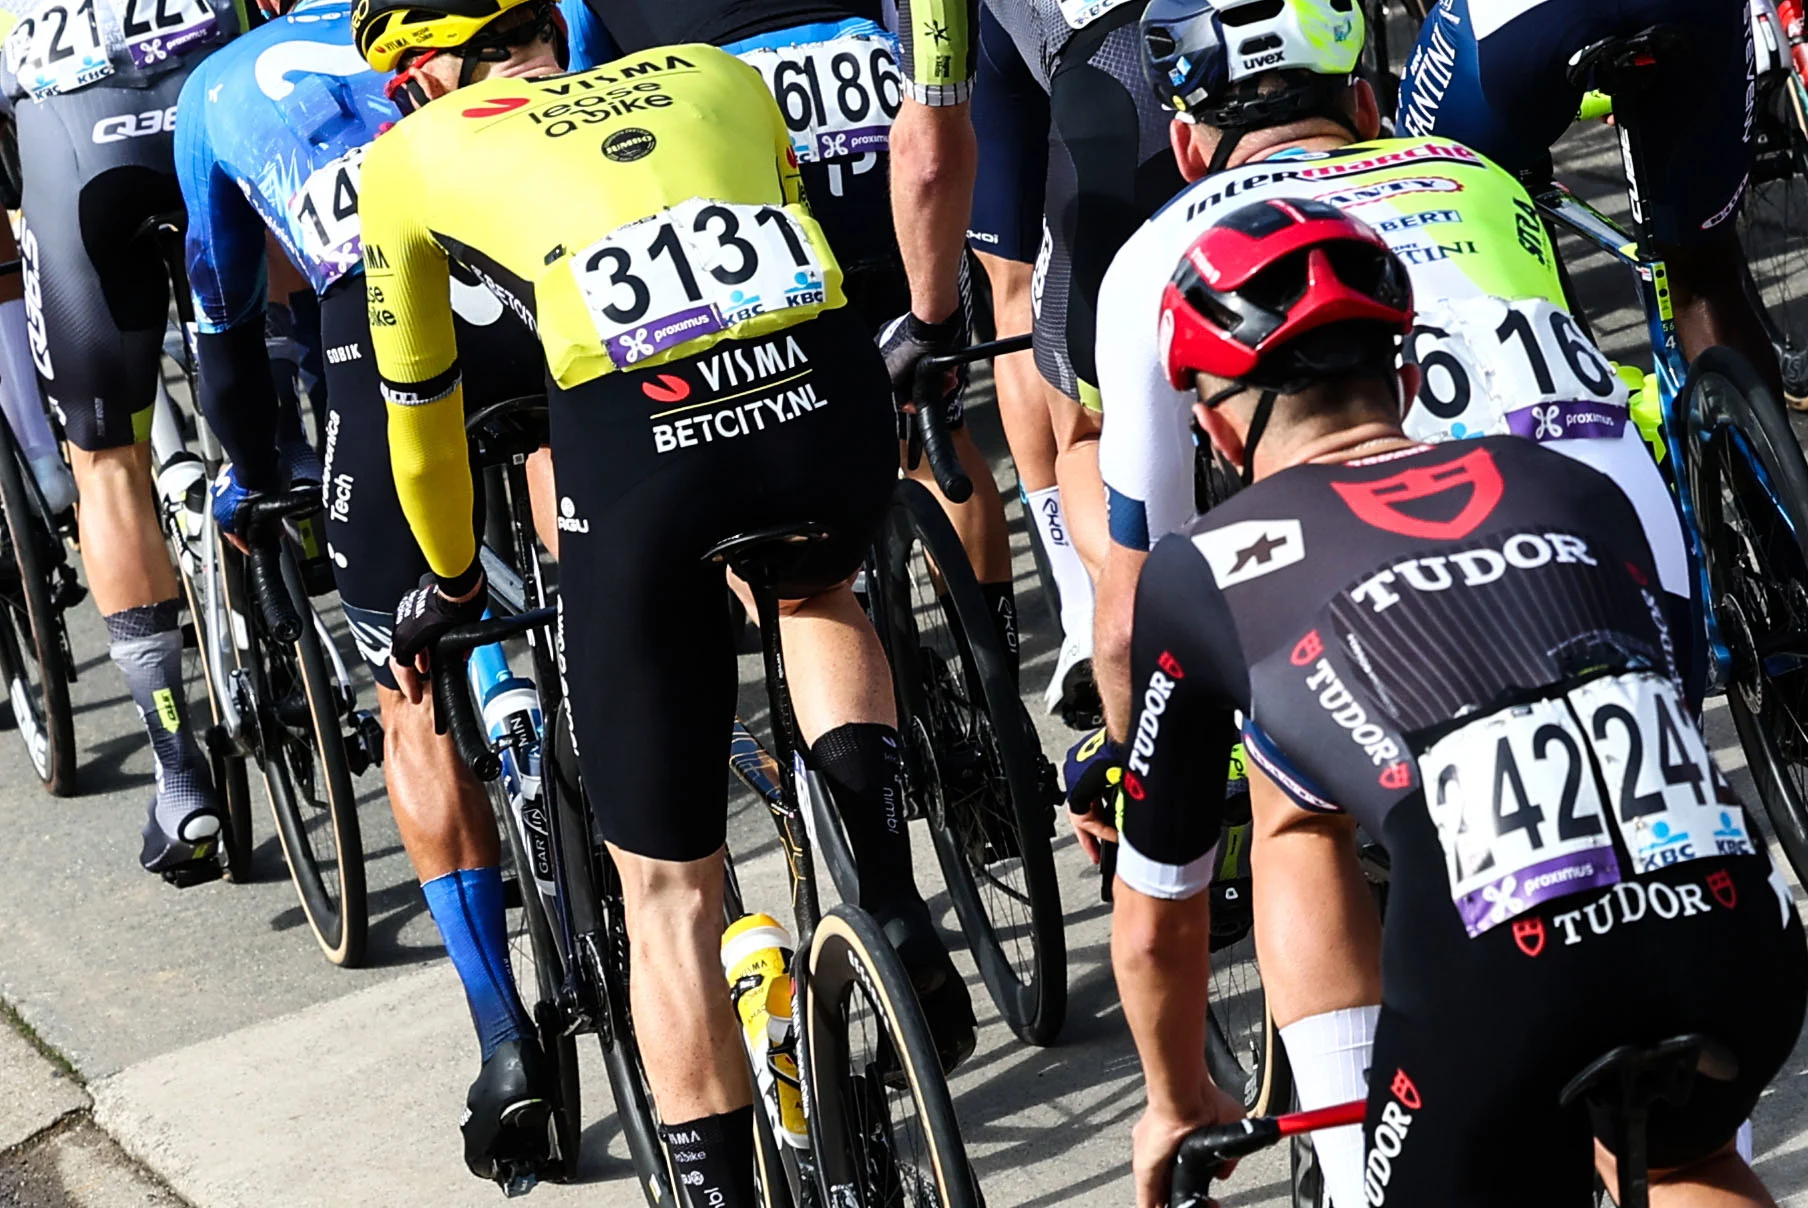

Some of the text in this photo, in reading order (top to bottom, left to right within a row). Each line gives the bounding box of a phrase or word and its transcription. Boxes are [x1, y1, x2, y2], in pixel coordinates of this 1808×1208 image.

[77, 66, 112, 86] KBC
[540, 54, 696, 97] VISMA
[800, 47, 901, 126] 186
[1243, 50, 1286, 70] uvex
[1404, 27, 1460, 138] FANTINI
[530, 81, 662, 125] lease
[606, 136, 654, 155] JUMBO
[692, 204, 811, 288] 31
[584, 224, 704, 326] 31
[652, 312, 711, 344] proximus
[723, 290, 824, 327] KBC KBC
[326, 342, 362, 364] GOBIK
[696, 335, 809, 393] VISMA
[1500, 308, 1616, 398] 16
[652, 384, 828, 454] BETCITY.NL
[1565, 408, 1615, 429] proximus
[330, 473, 354, 522] Tech
[1351, 532, 1599, 614] TUDOR
[1128, 671, 1176, 777] TUDOR
[1305, 660, 1401, 771] TUDOR
[1713, 833, 1756, 858] KBC
[1522, 860, 1595, 898] proximus
[1553, 882, 1712, 947] TUDOR
[1364, 1101, 1413, 1207] UDOR
